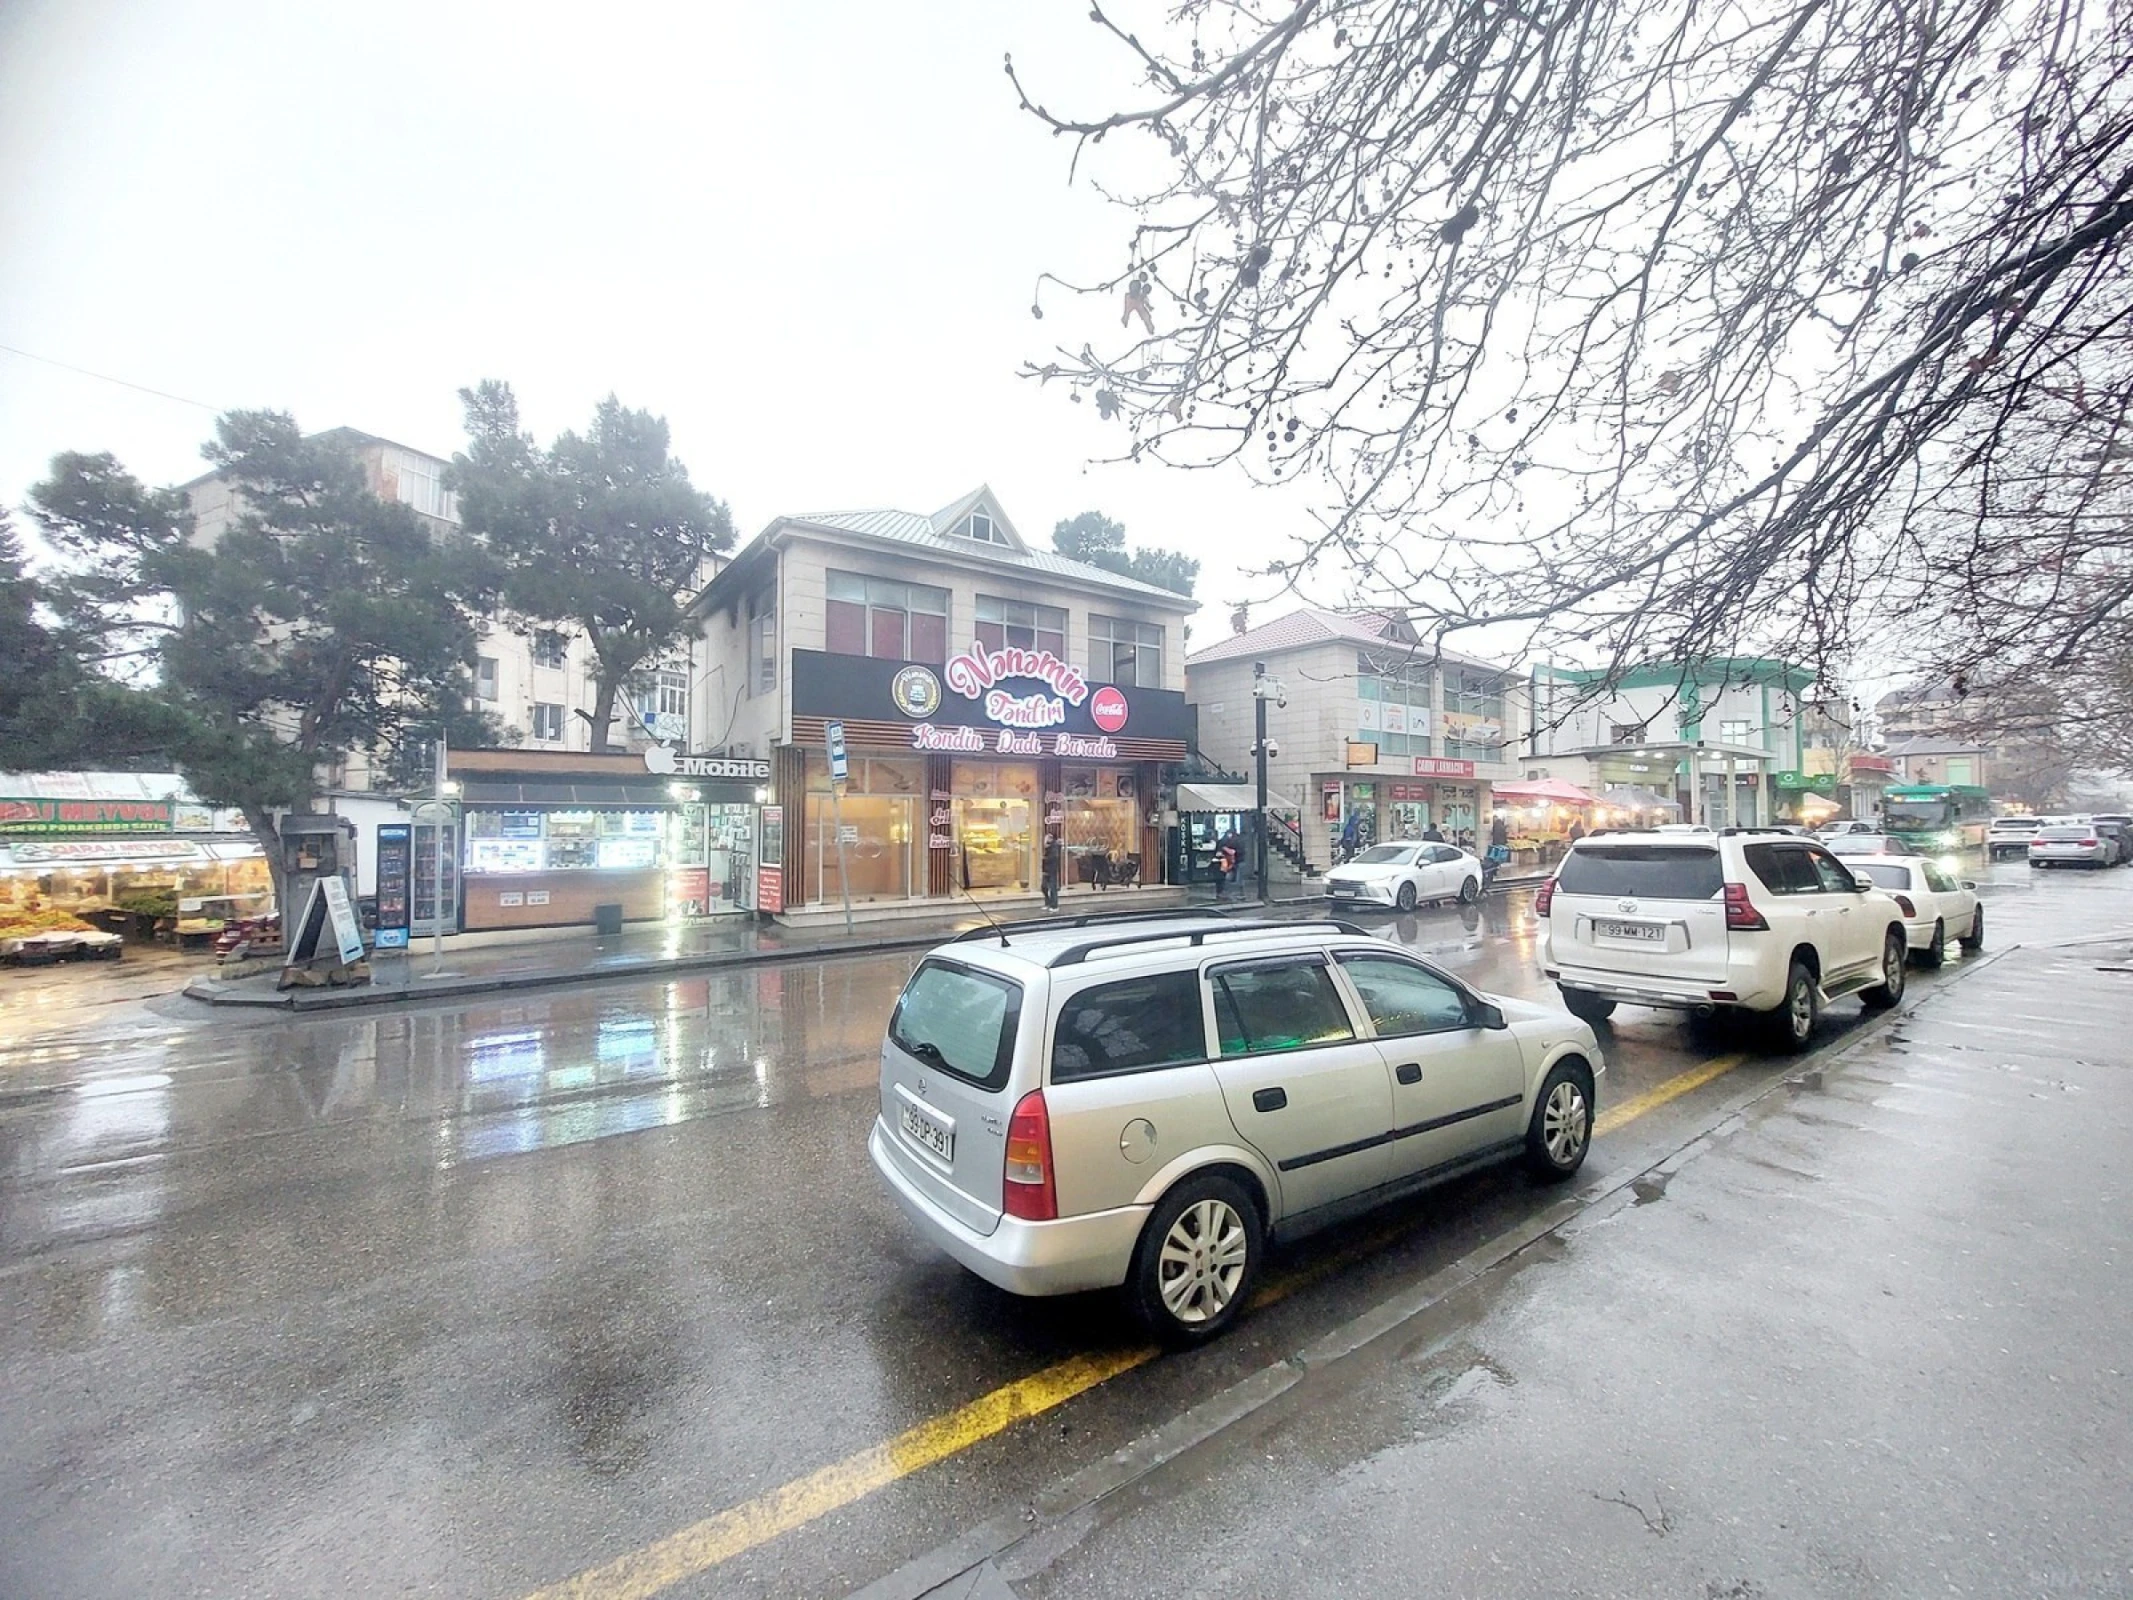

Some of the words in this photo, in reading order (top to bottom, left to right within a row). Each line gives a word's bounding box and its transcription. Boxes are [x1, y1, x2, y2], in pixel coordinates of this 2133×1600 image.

[947, 641, 1087, 705] Nənəmin
[987, 691, 1064, 726] Təndiri
[912, 723, 984, 750] Kəndin
[1055, 733, 1117, 757] Burada
[683, 759, 769, 777] Mobile
